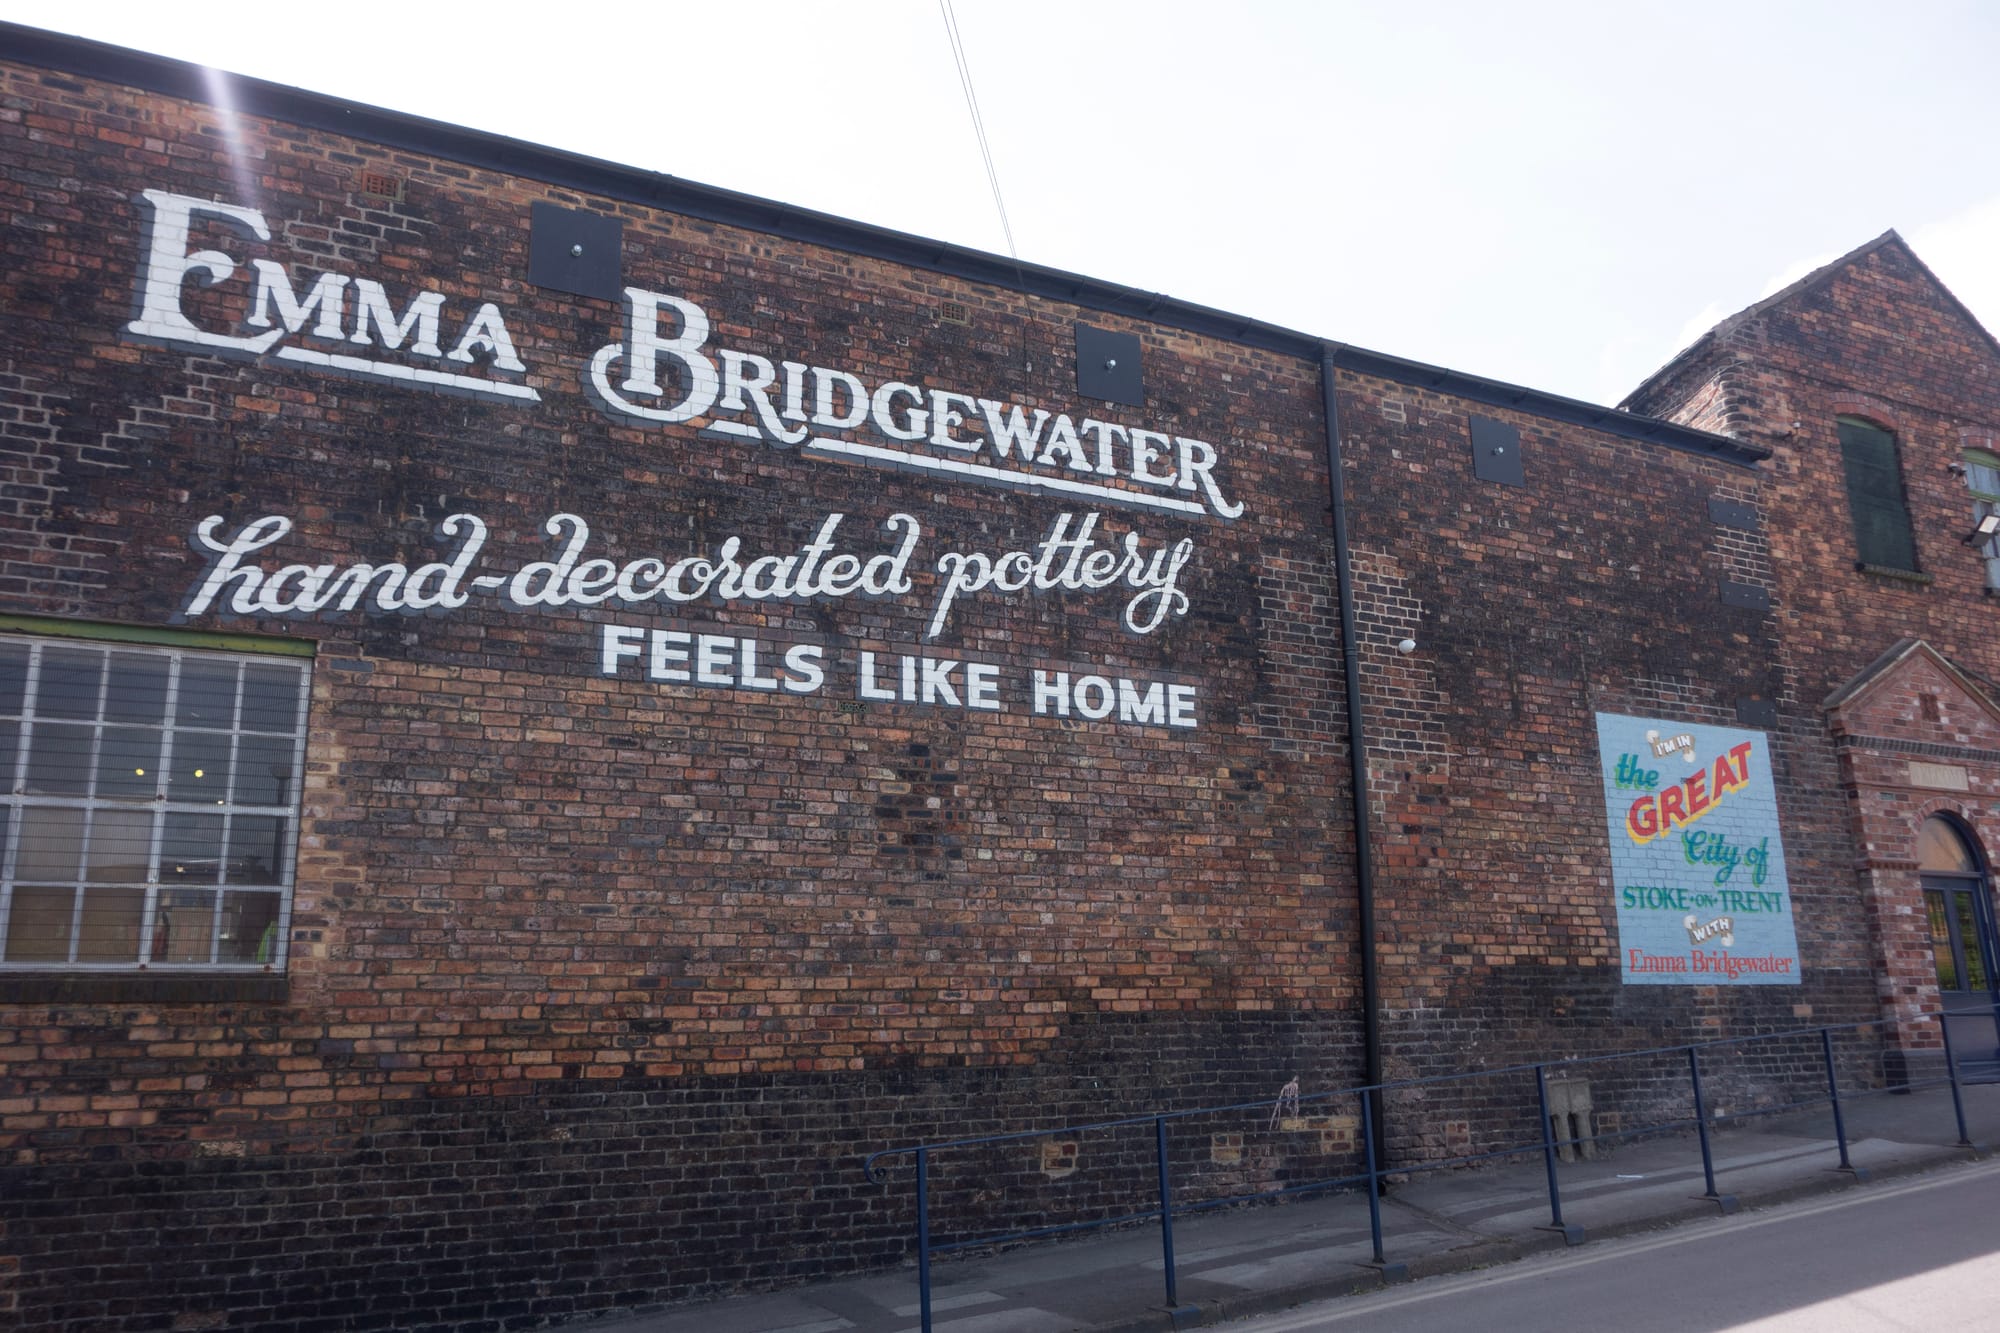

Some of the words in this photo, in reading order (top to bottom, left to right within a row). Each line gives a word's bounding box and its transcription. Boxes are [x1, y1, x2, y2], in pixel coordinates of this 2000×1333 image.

[128, 188, 527, 373] EMMA
[590, 286, 1245, 519] BRIDGEWATER
[184, 512, 921, 617] hand-decorated
[928, 511, 1194, 639] pottery
[601, 624, 824, 693] FEELS
[861, 650, 1000, 709] LIKE
[1034, 669, 1198, 728] HOME
[1615, 753, 1659, 788] the
[1656, 740, 1676, 756] I'M
[1677, 735, 1692, 747] IN
[1627, 741, 1752, 841] GREAT
[1683, 830, 1741, 886] City
[1745, 837, 1769, 886] of
[1692, 918, 1730, 942] WITH
[1629, 949, 1688, 973] Emma
[1691, 950, 1793, 979] Bridgewater
